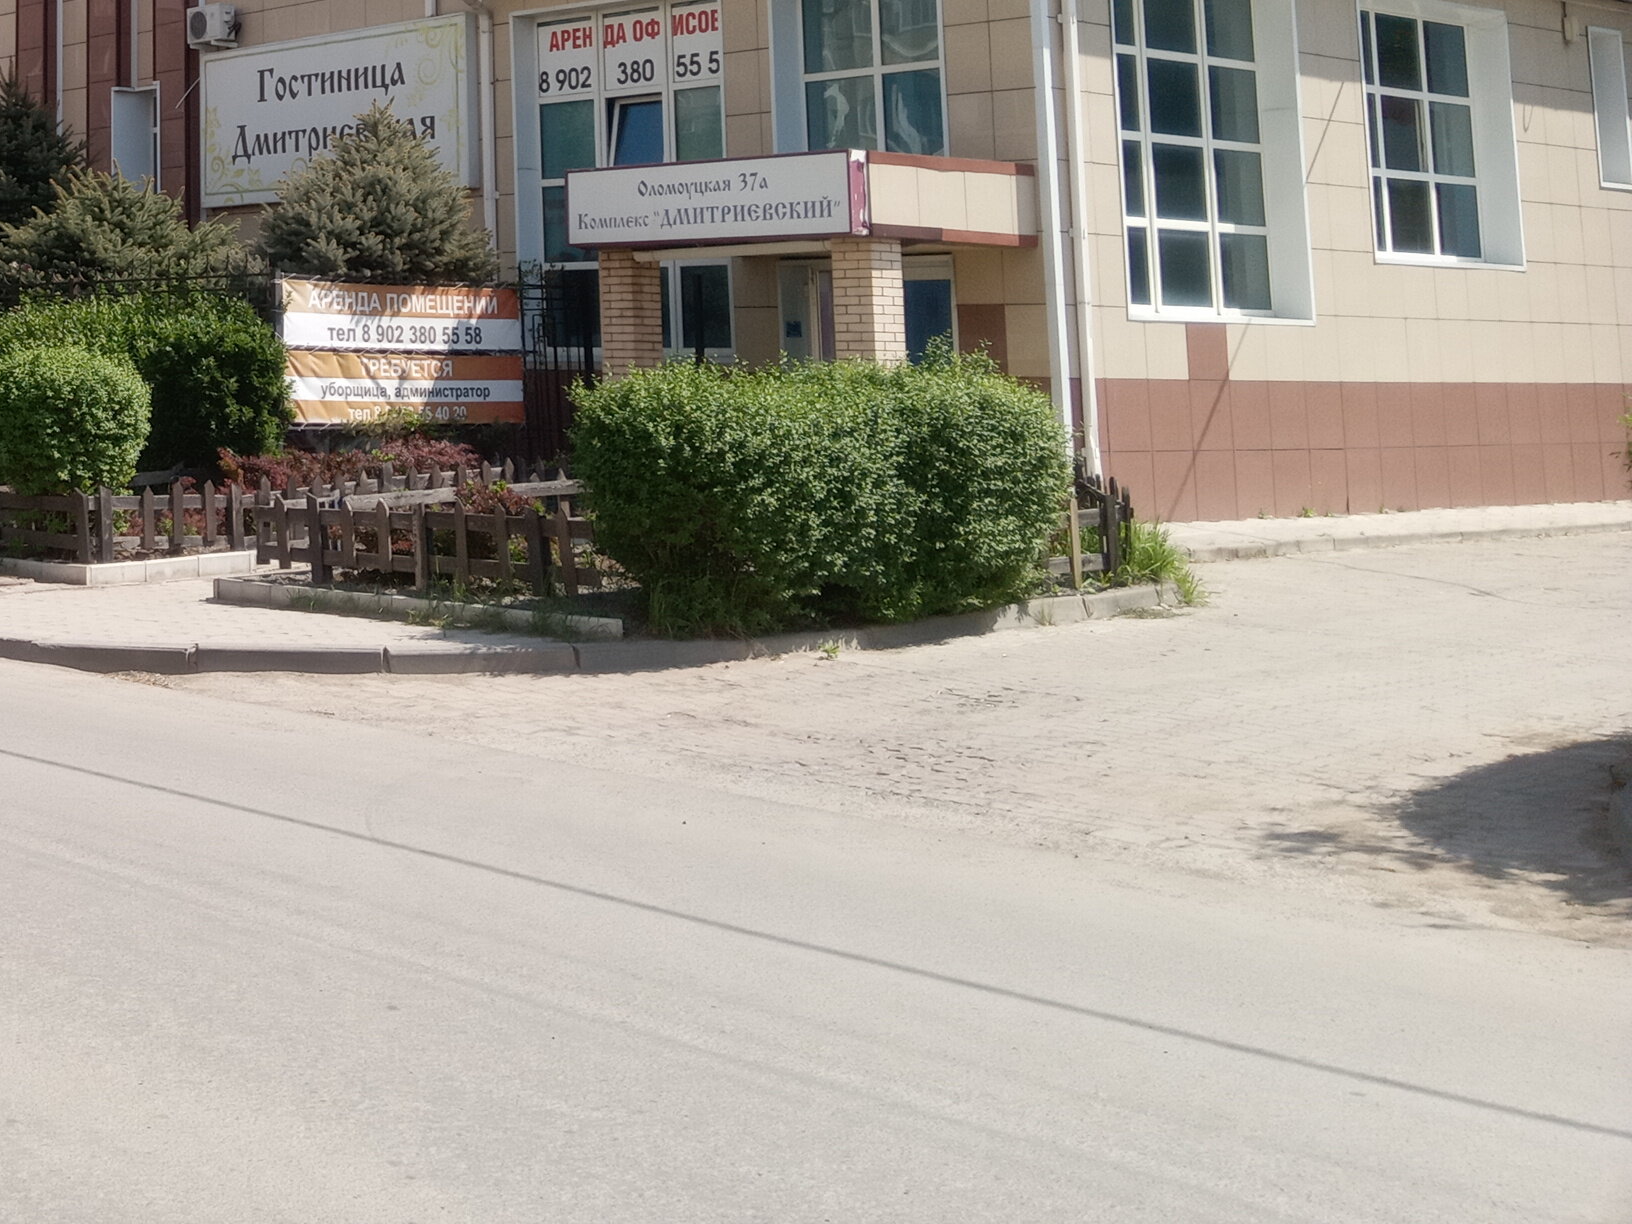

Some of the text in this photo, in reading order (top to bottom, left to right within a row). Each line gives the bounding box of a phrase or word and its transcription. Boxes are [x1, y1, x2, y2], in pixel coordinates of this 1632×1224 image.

[257, 62, 406, 103] Гостиница
[539, 70, 550, 93] 8
[555, 66, 592, 91] 902
[617, 58, 655, 85] 380
[675, 52, 702, 78] 55
[637, 176, 732, 200] Оломоуцкая
[577, 212, 649, 231] Комплекс
[308, 289, 498, 317] АРЕНДА ПОМЕЩЕНИЙ
[327, 324, 483, 345] тел 8 902 380 55 58
[361, 356, 453, 377] ТРЕБУЕТСЯ
[320, 381, 491, 401] уборщица, администратор
[435, 405, 450, 420] 40
